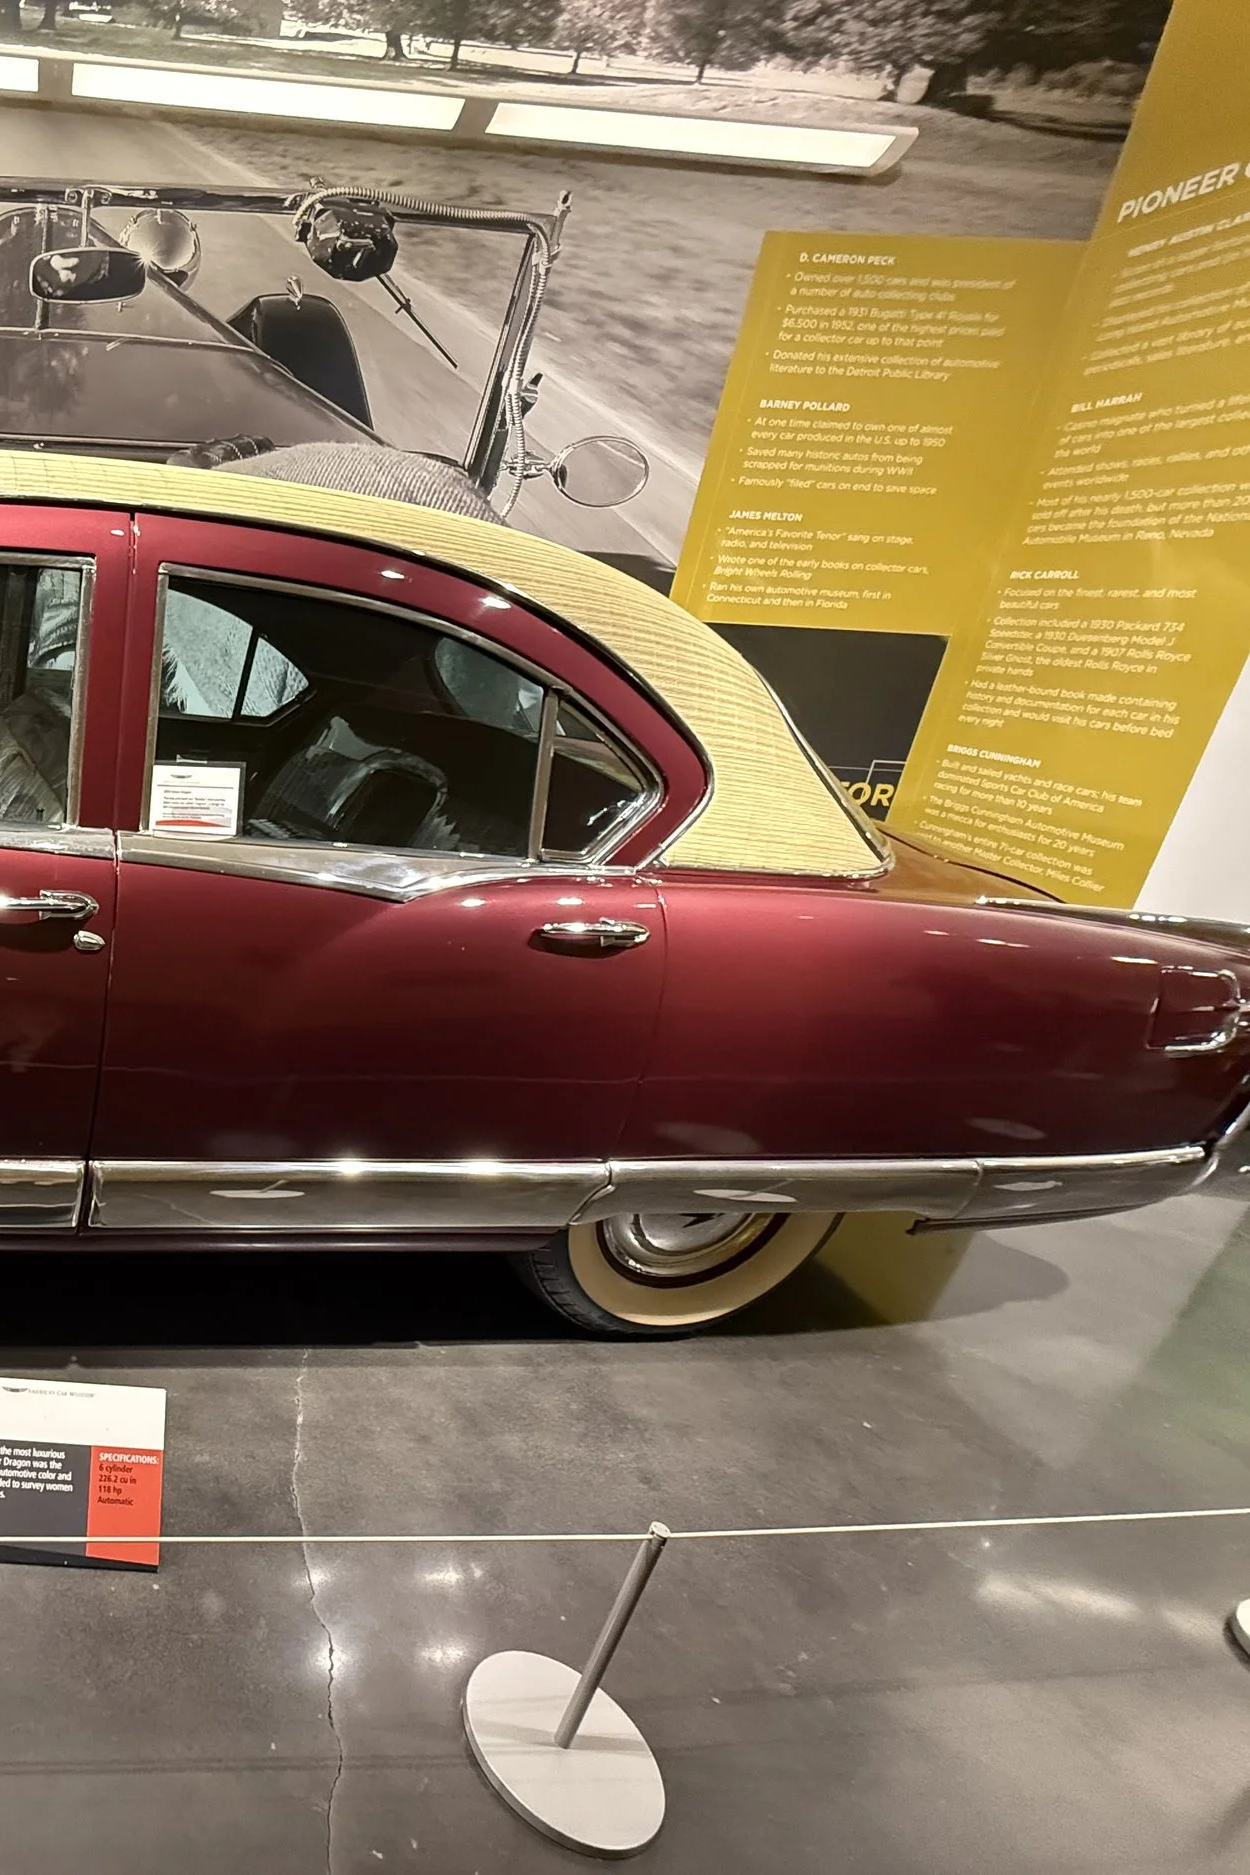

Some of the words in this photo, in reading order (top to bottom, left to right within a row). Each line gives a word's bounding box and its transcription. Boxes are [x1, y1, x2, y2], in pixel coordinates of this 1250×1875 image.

[1117, 162, 1240, 223] PIONEER
[799, 252, 809, 262] D.
[812, 253, 865, 264] CAMERON
[867, 255, 895, 265] PECK
[773, 349, 815, 360] Donated
[816, 352, 830, 361] his
[832, 353, 879, 363] extensive
[880, 354, 928, 365] collection
[930, 356, 942, 366] of
[942, 358, 1000, 368] automotive
[759, 399, 801, 409] BARNEY
[802, 400, 850, 411] POLLARD
[1070, 401, 1092, 413] BILL
[1095, 392, 1142, 408] HARRAH
[746, 446, 776, 456] Saved
[777, 450, 803, 462] many
[805, 449, 840, 459] historic
[842, 452, 869, 461] autos
[871, 452, 894, 462] from
[895, 453, 922, 465] being
[728, 510, 761, 519] JAMES
[762, 511, 802, 521] MELTON
[1033, 570, 1078, 579] CARROLL
[709, 581, 727, 590] Ran
[729, 583, 742, 592] his
[765, 585, 818, 595] automotive
[862, 589, 880, 599] first
[706, 593, 761, 604] Connecticut
[762, 597, 781, 605] and
[782, 598, 803, 606] then
[815, 599, 847, 609] Florida
[946, 743, 978, 756] BRIGGS
[978, 749, 1041, 768] CUNNINGHAM
[840, 781, 895, 807] OR
[0, 1445, 12, 1455] the
[12, 1448, 31, 1456] most
[32, 1447, 65, 1459] luxurious
[99, 1452, 158, 1464] SPECIFICATIONS:
[3, 1456, 31, 1468] Dragon
[32, 1460, 47, 1468] was
[49, 1459, 62, 1469] the
[37, 1470, 56, 1479] color
[56, 1471, 71, 1480] and
[98, 1463, 103, 1471] 6
[105, 1463, 132, 1477] cylinder
[11, 1479, 20, 1488] to
[21, 1482, 44, 1492] survey
[45, 1483, 73, 1491] women
[98, 1474, 118, 1483] 226.2
[129, 1476, 136, 1484] in
[98, 1485, 110, 1493] 118
[112, 1485, 122, 1495] hp
[97, 1495, 133, 1505] Automatic
